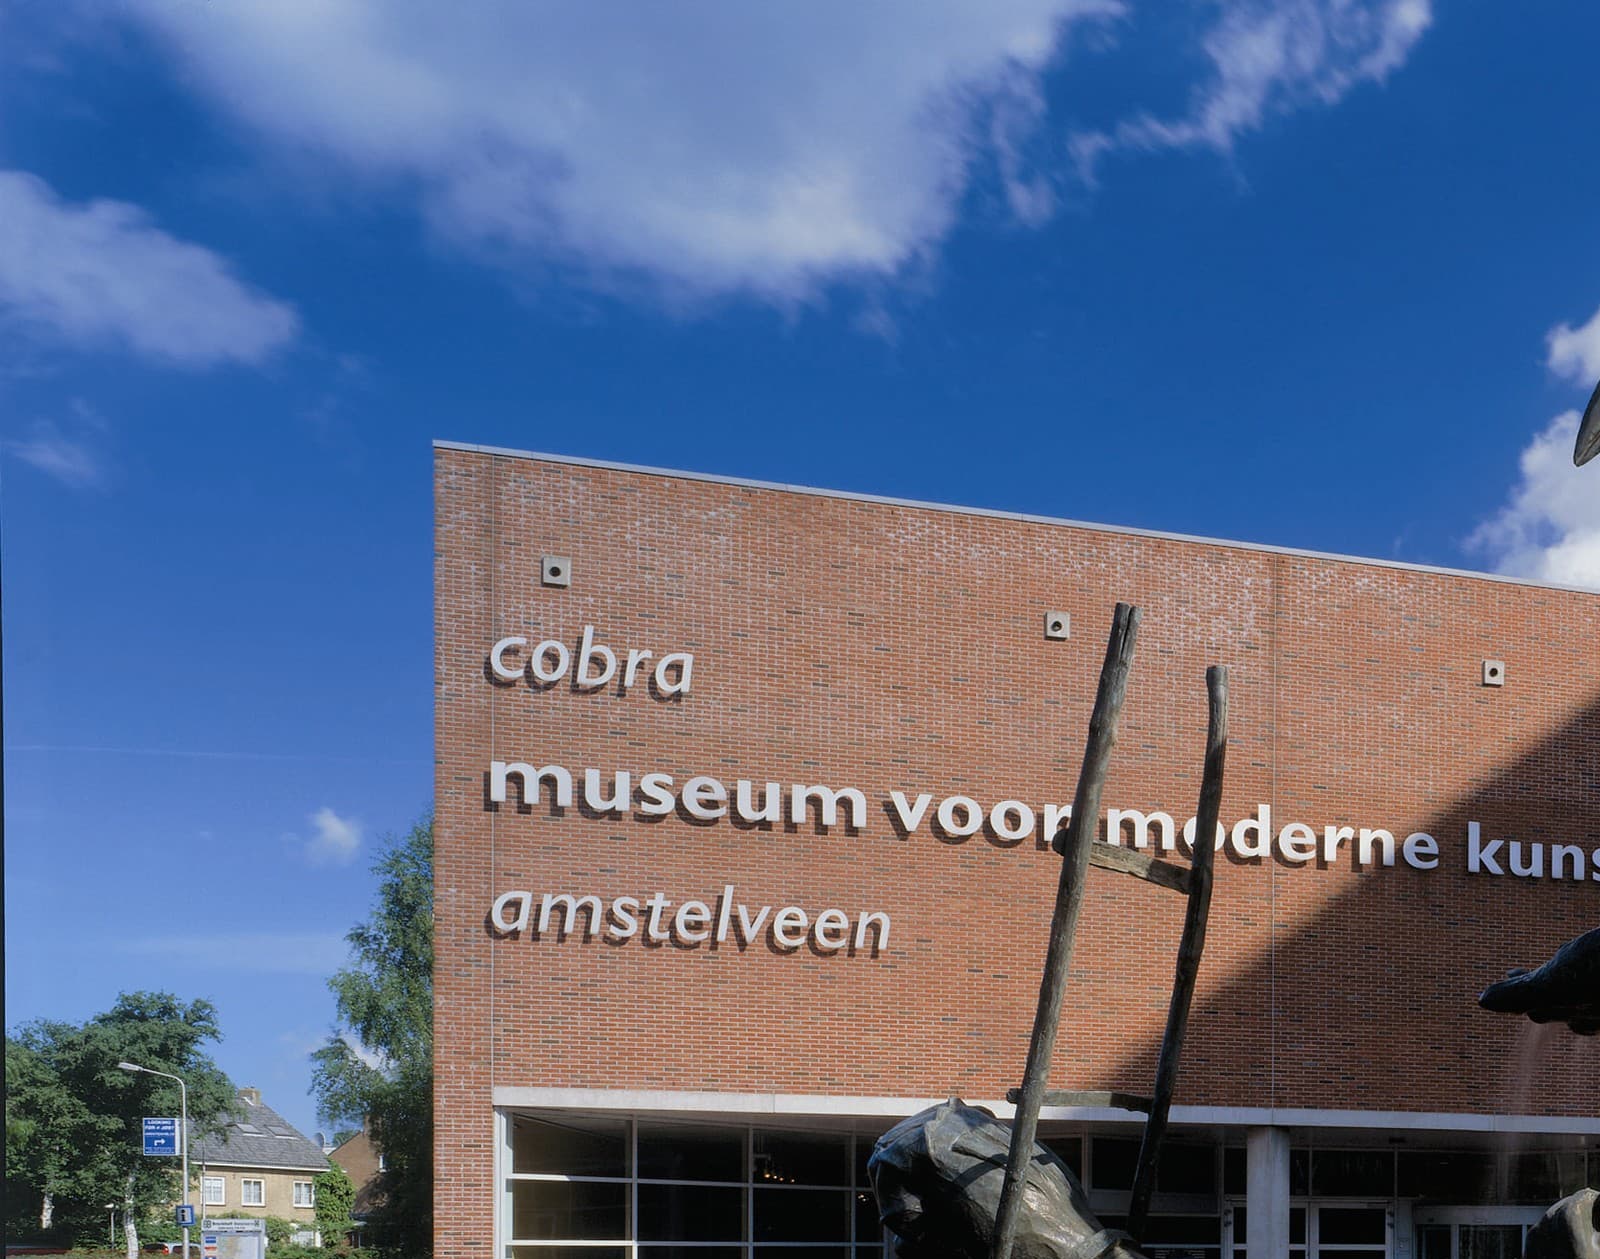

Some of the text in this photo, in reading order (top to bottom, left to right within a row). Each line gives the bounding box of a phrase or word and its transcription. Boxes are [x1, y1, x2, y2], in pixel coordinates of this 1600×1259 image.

[489, 624, 695, 695] cobra
[489, 760, 868, 829] museum
[889, 790, 1074, 843] voor
[1106, 803, 1440, 871] moderne
[490, 884, 892, 952] amstelveen
